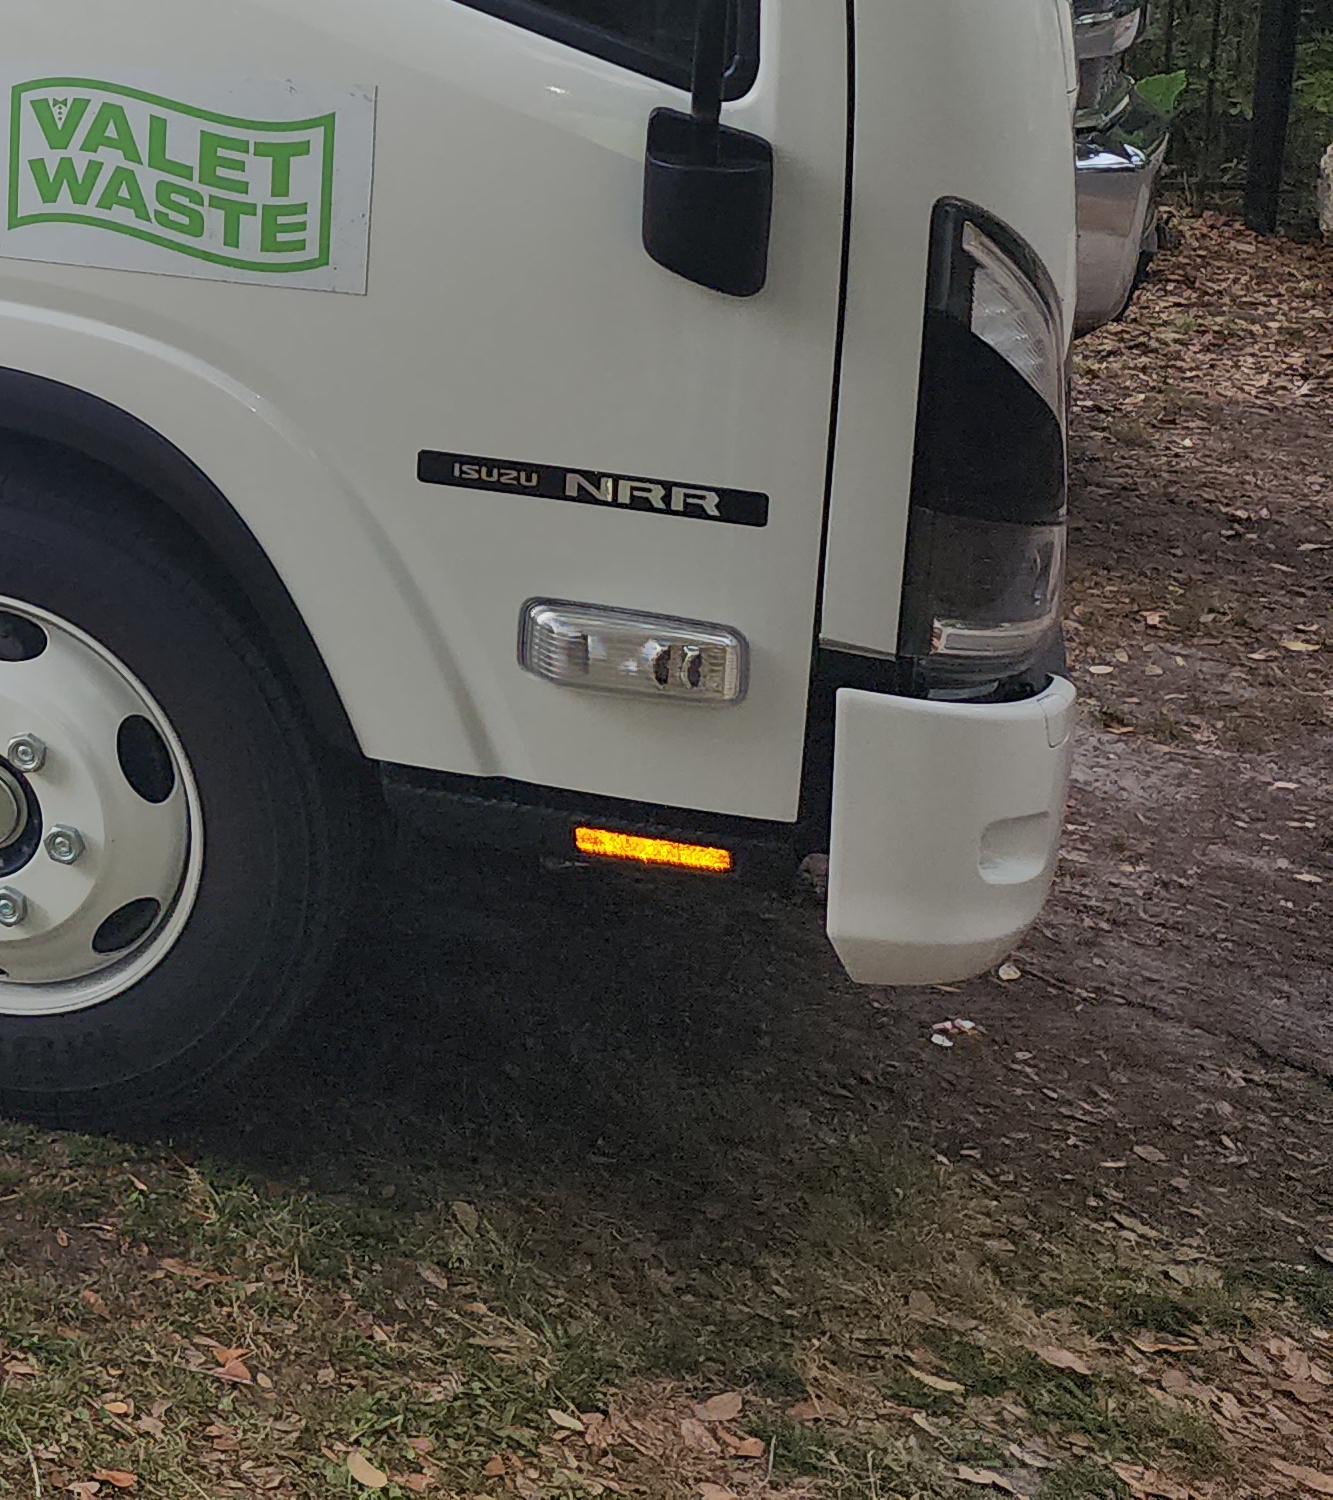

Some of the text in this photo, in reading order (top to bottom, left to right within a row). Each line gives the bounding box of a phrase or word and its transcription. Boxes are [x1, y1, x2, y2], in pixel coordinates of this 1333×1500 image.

[29, 97, 311, 198] VALET
[27, 156, 308, 253] WASTE
[453, 461, 538, 487] ISUZU
[564, 472, 720, 517] NRR
